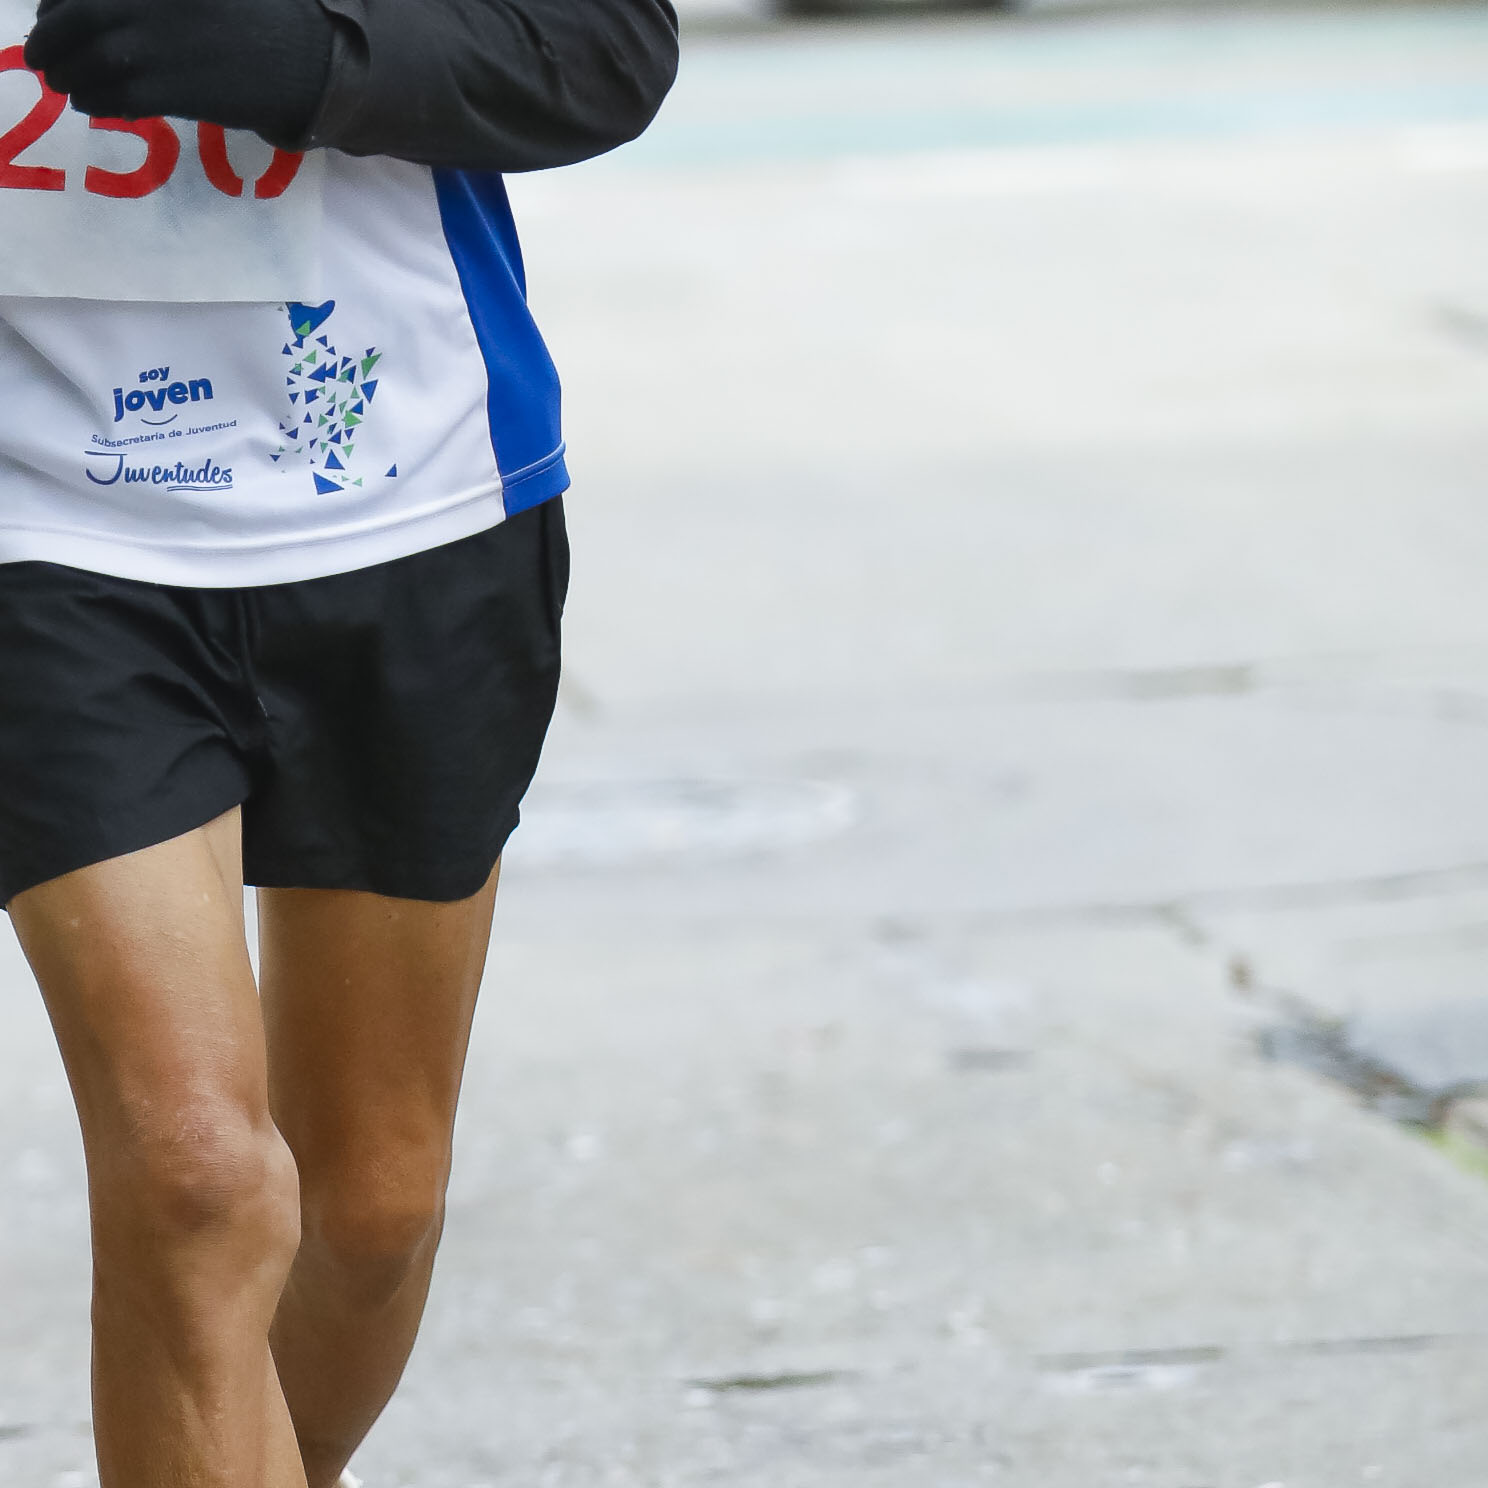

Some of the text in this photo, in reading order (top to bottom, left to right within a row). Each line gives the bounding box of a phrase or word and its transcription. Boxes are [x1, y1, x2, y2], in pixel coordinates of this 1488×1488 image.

[139, 366, 170, 383] soy
[113, 378, 213, 422] joven
[168, 429, 182, 438] de
[185, 420, 237, 436] Juventud
[84, 450, 233, 486] Juventudes
